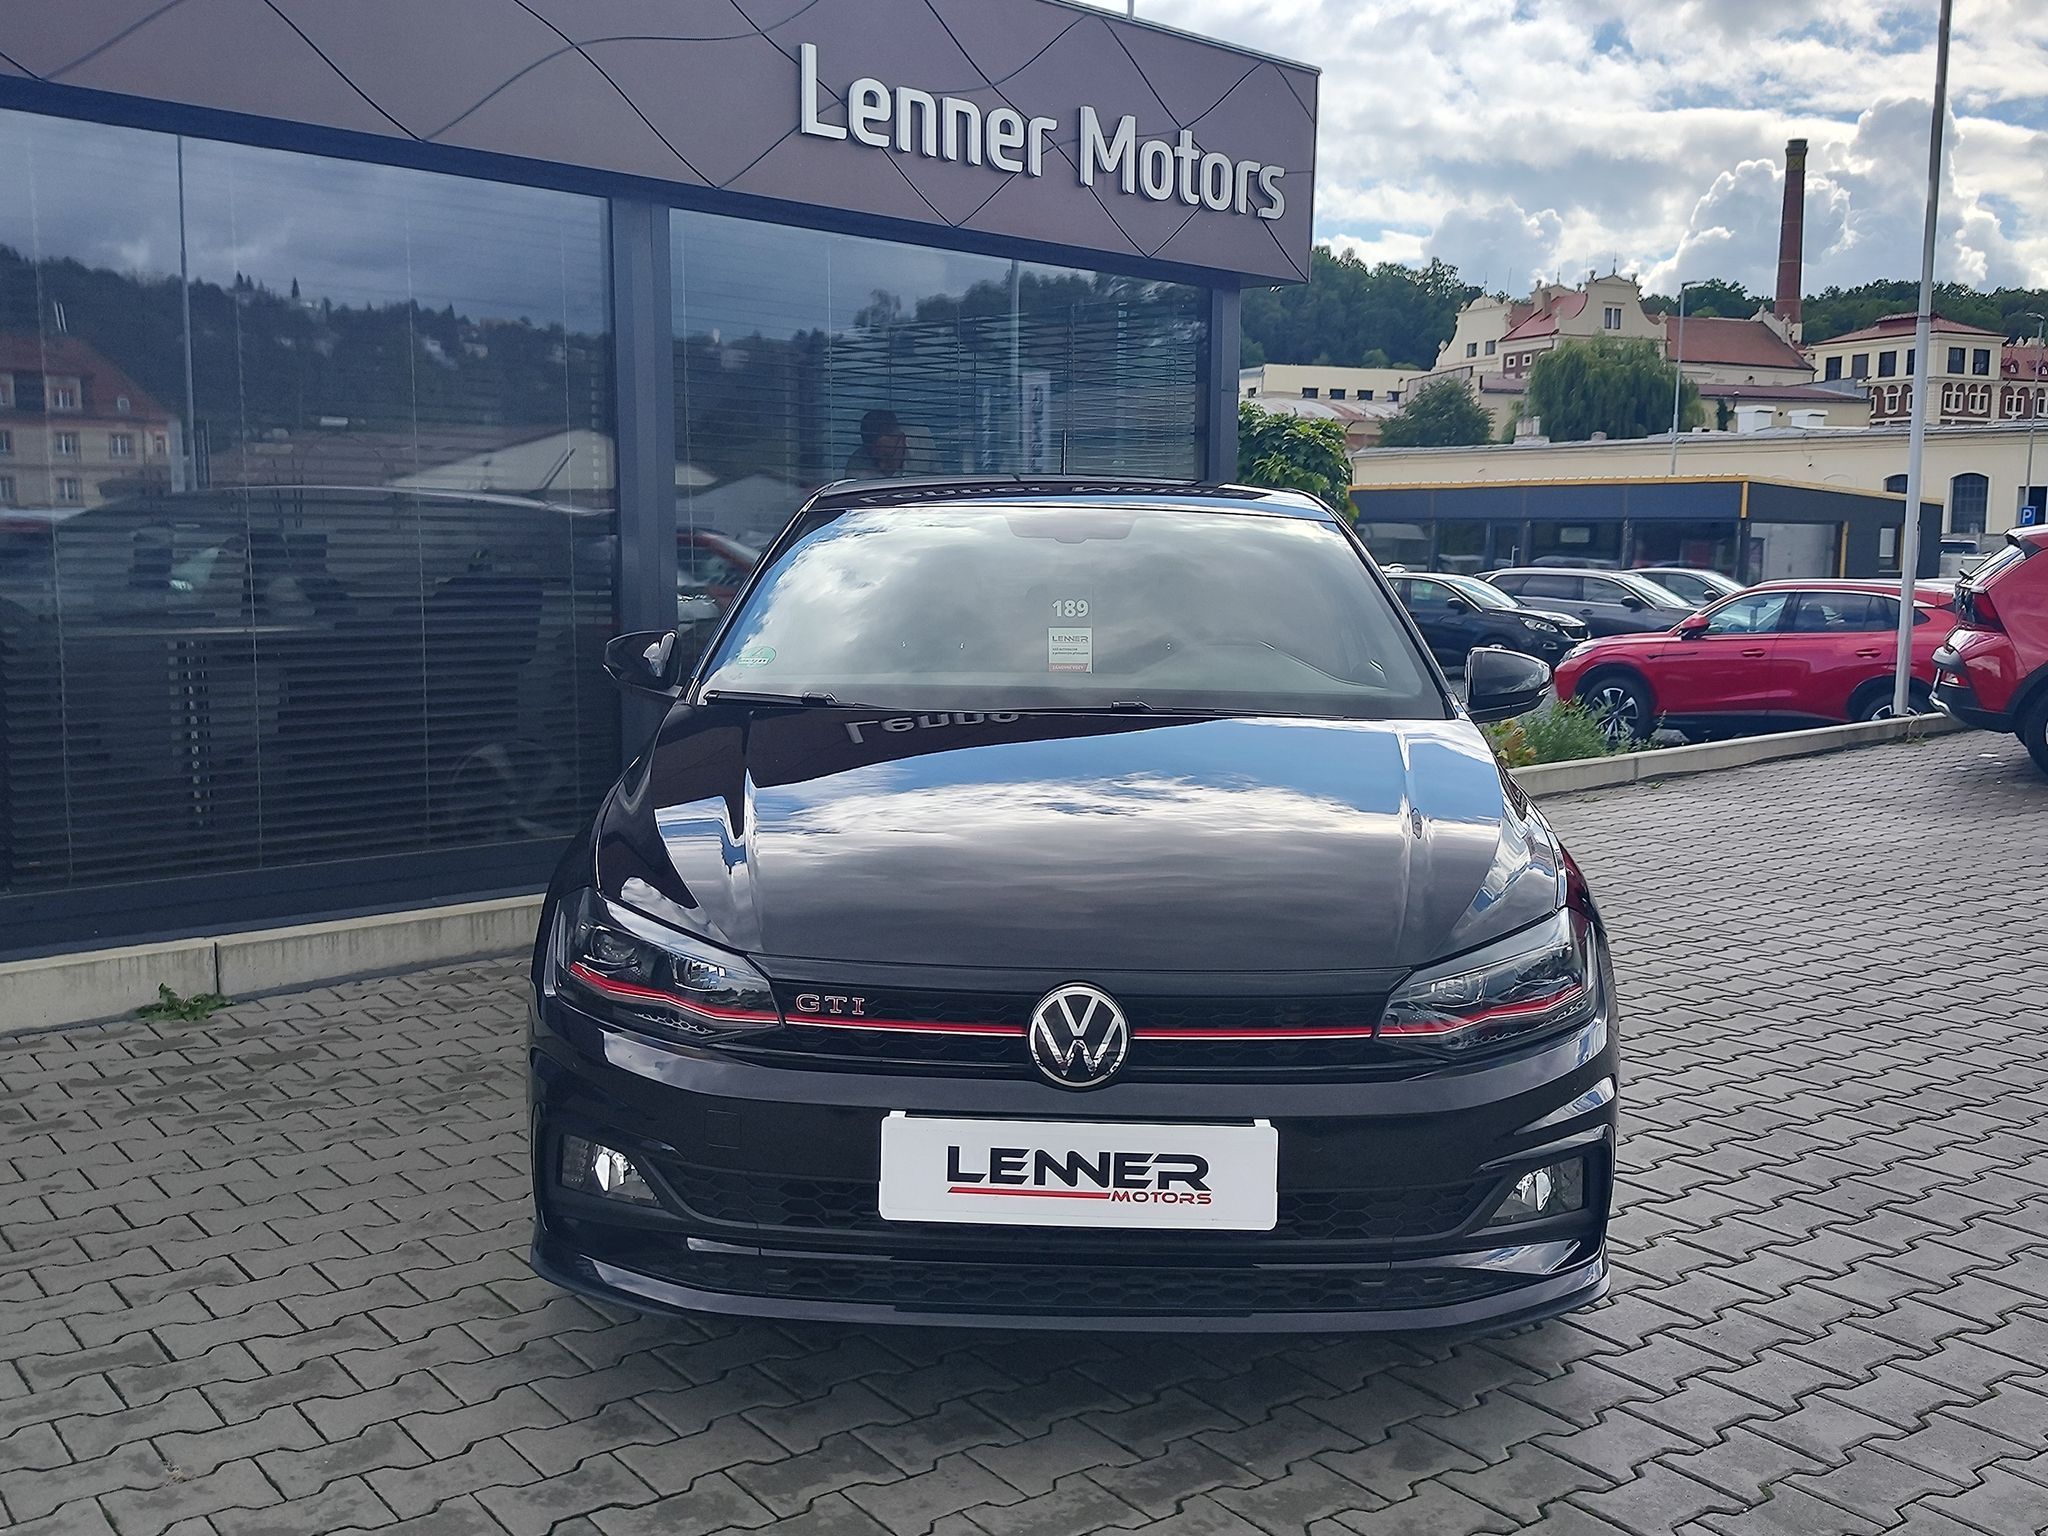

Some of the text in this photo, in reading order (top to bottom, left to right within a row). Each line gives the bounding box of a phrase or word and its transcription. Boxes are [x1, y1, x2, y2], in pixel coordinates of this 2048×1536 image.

[800, 43, 1286, 220] Lenner Motors
[2022, 508, 2032, 524] P
[1052, 599, 1089, 617] 189
[795, 993, 866, 1016] GTI
[946, 1145, 1213, 1192] LENNER
[1109, 1190, 1213, 1206] MOTORS
